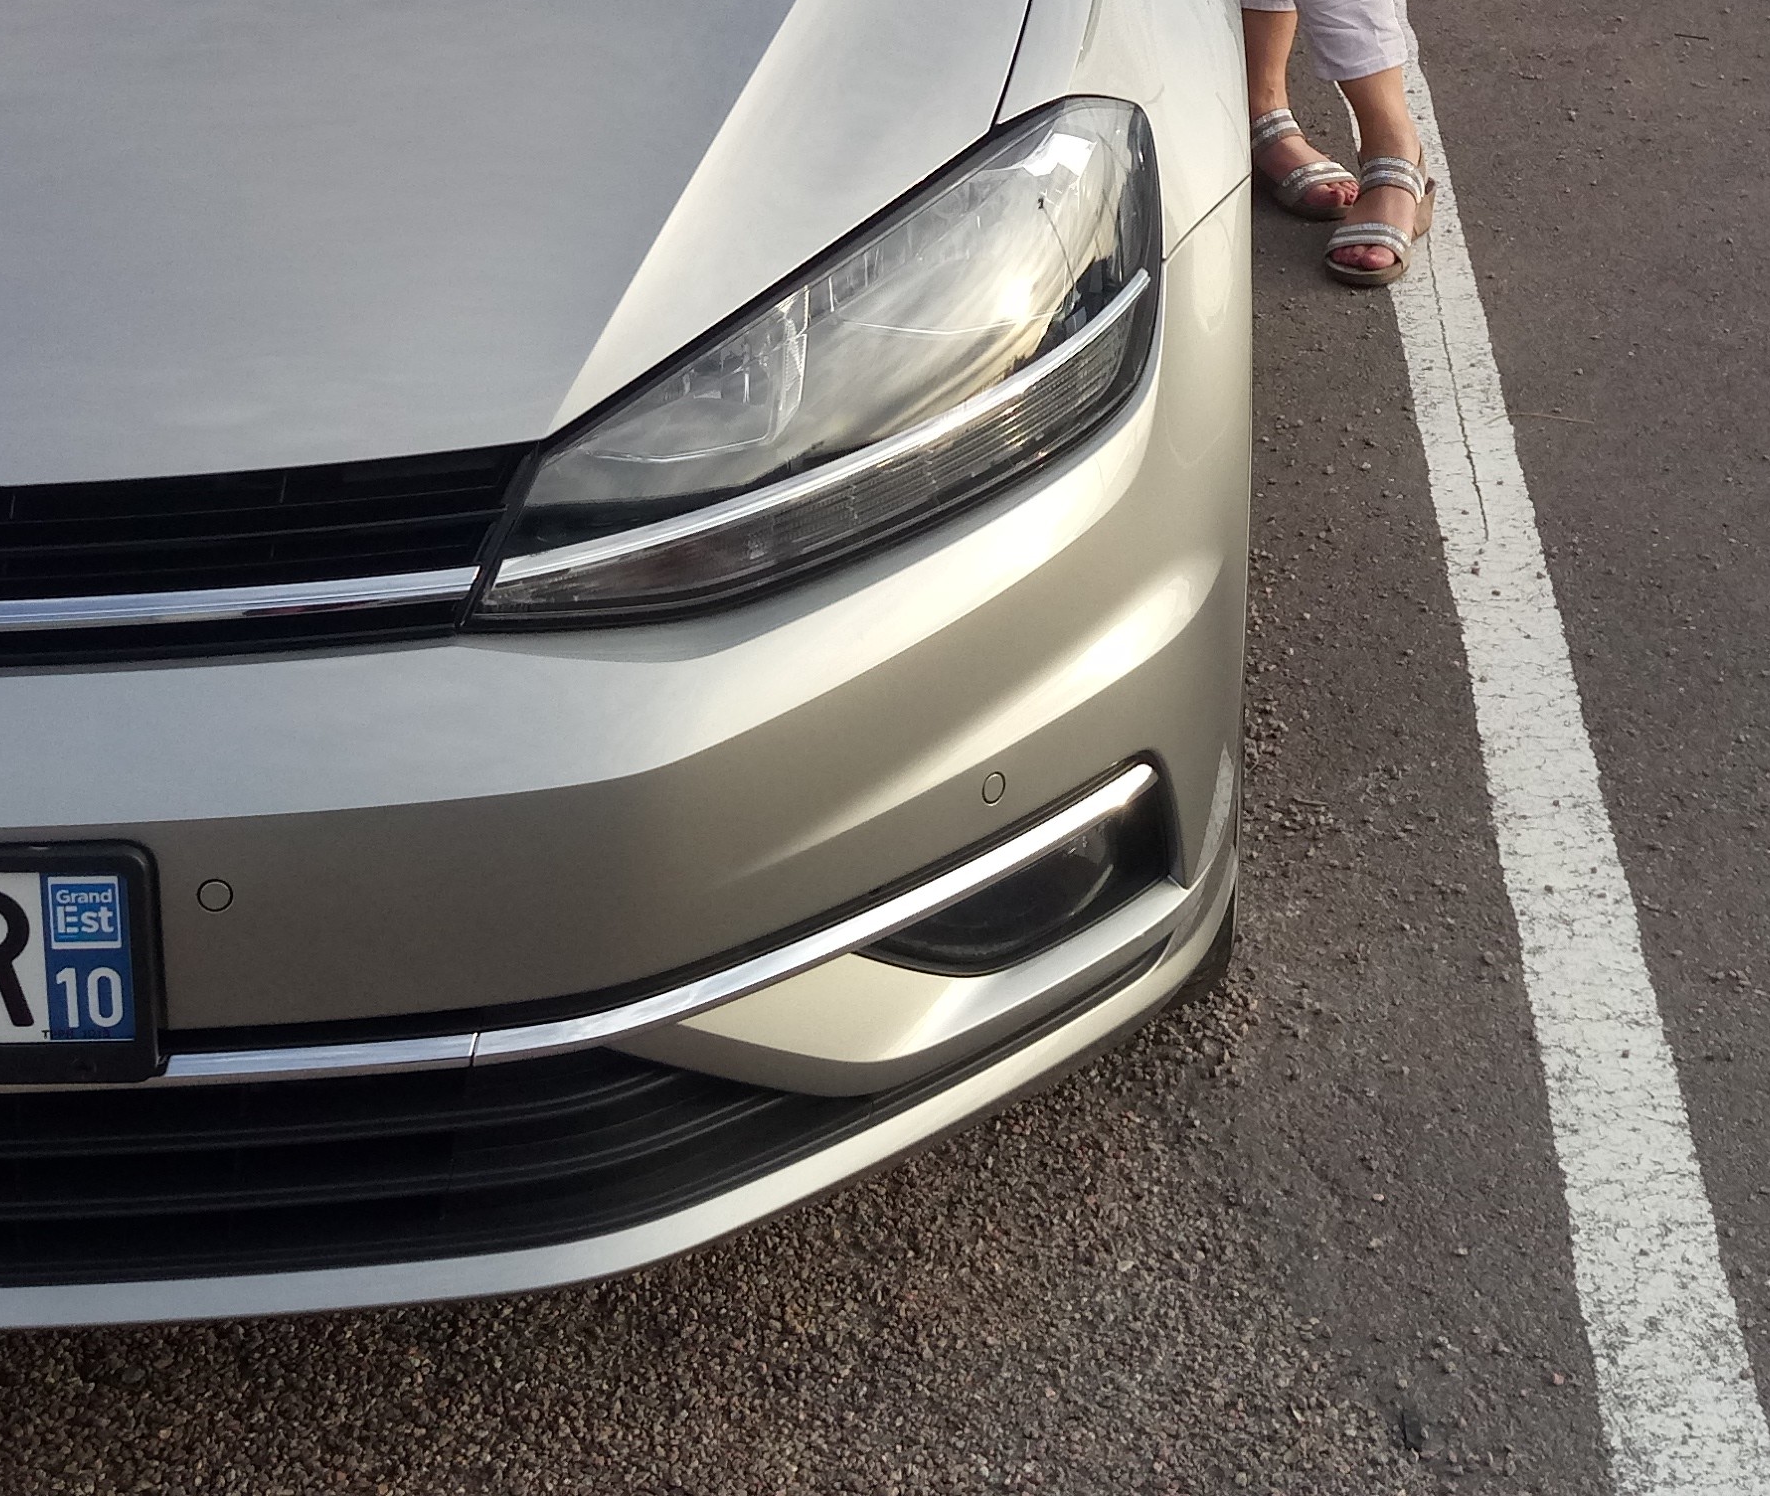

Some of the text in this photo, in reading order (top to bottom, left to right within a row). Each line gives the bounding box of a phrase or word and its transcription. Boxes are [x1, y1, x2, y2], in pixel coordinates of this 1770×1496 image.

[56, 889, 113, 904] Grand
[57, 905, 115, 934] Est
[55, 967, 124, 1029] 10
